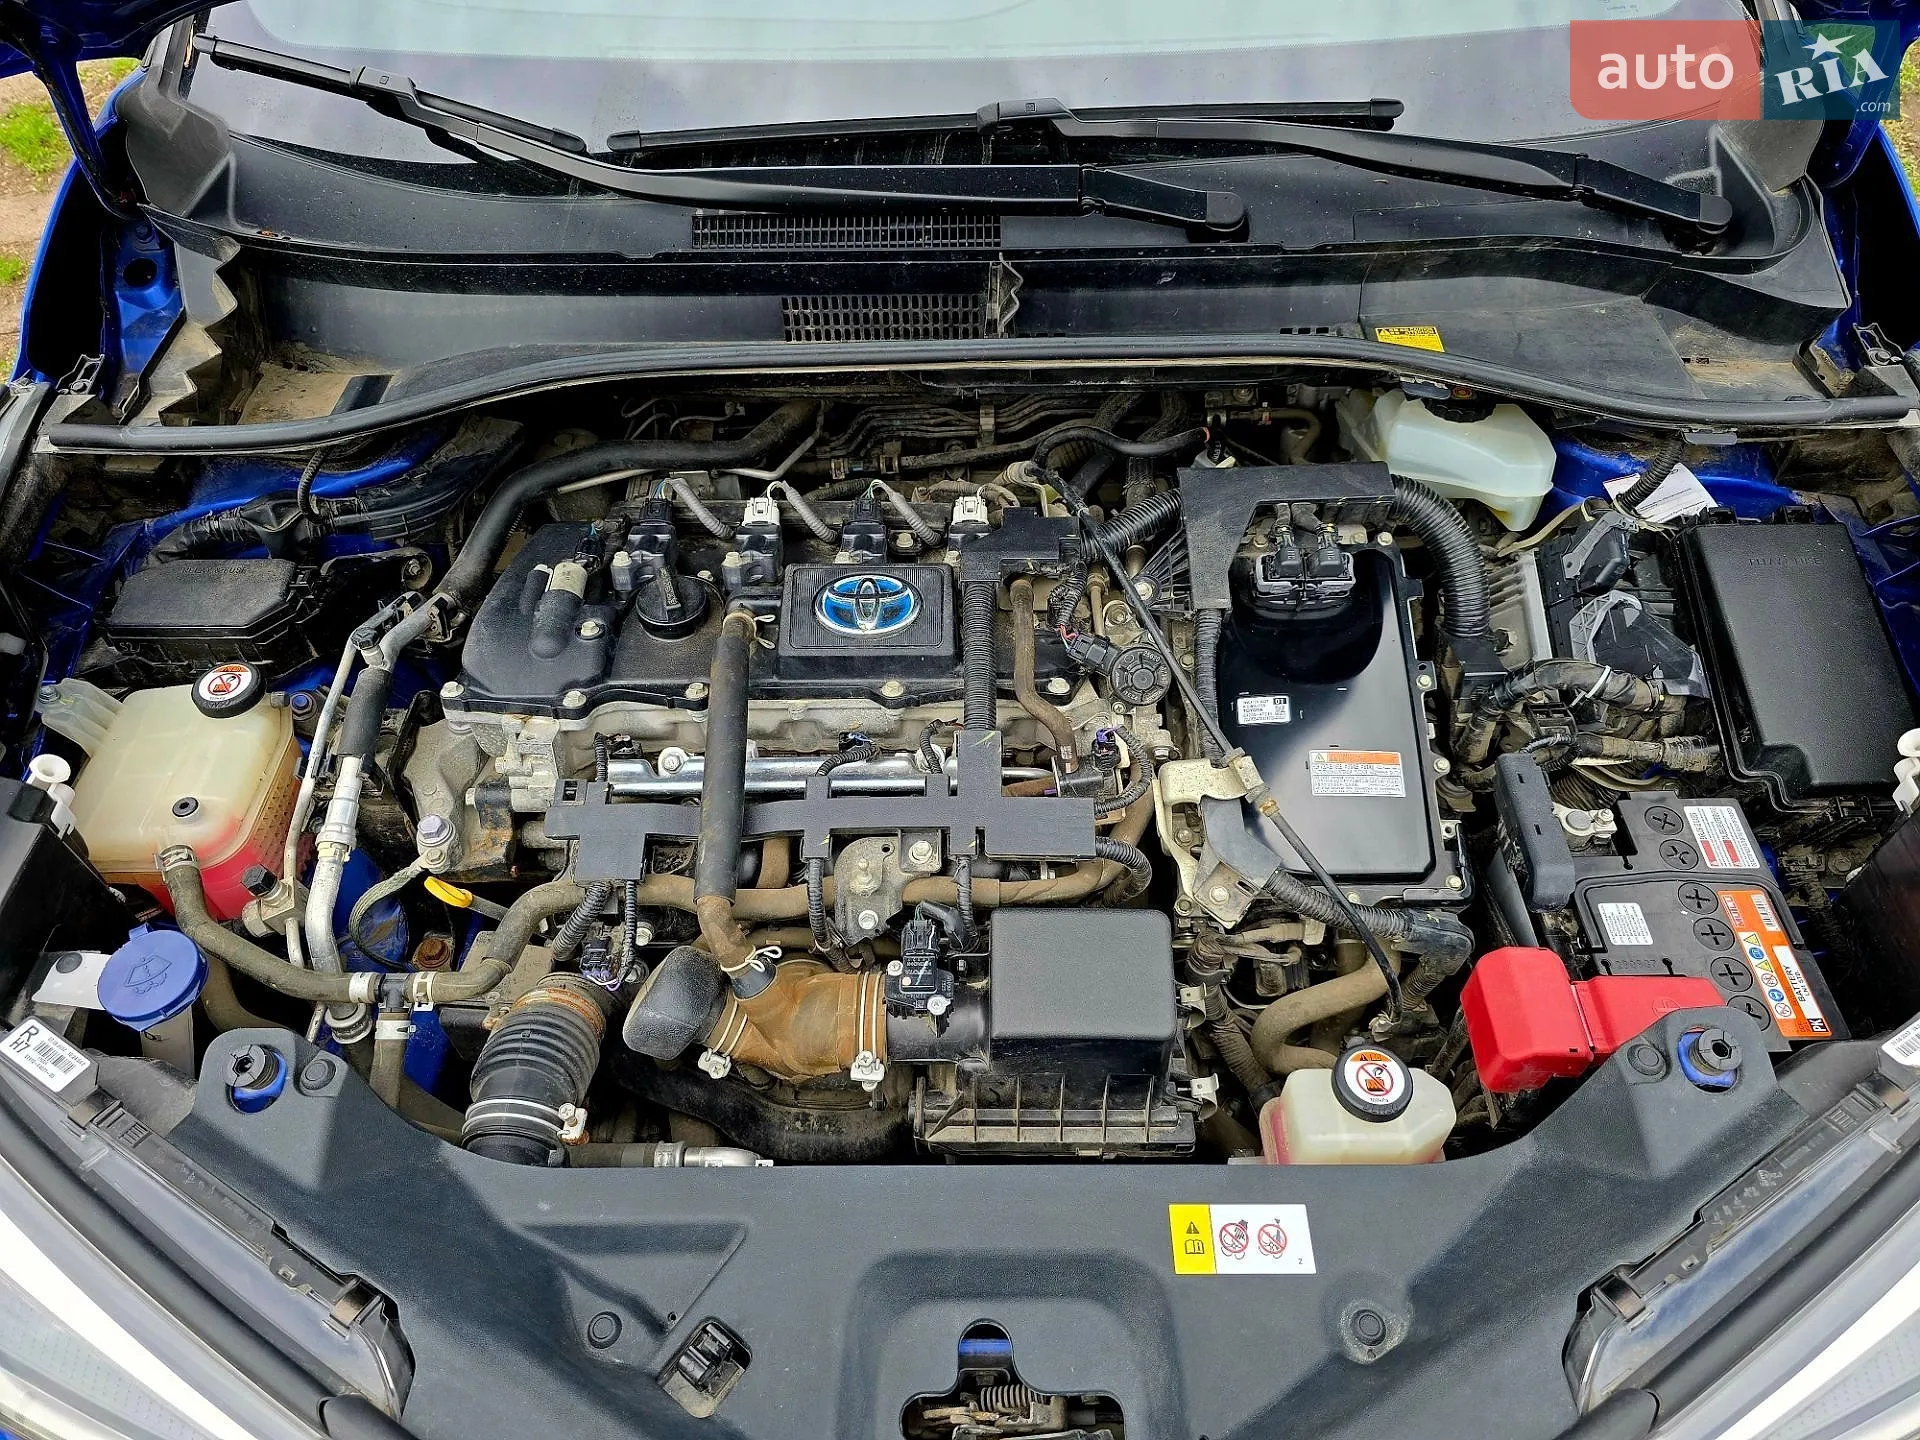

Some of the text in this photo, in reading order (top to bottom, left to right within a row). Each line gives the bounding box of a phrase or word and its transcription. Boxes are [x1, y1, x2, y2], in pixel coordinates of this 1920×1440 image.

[1782, 964, 1806, 1002] BATTERY
[19, 1025, 40, 1043] R
[1813, 1019, 1828, 1032] PK
[9, 1037, 31, 1053] H7
